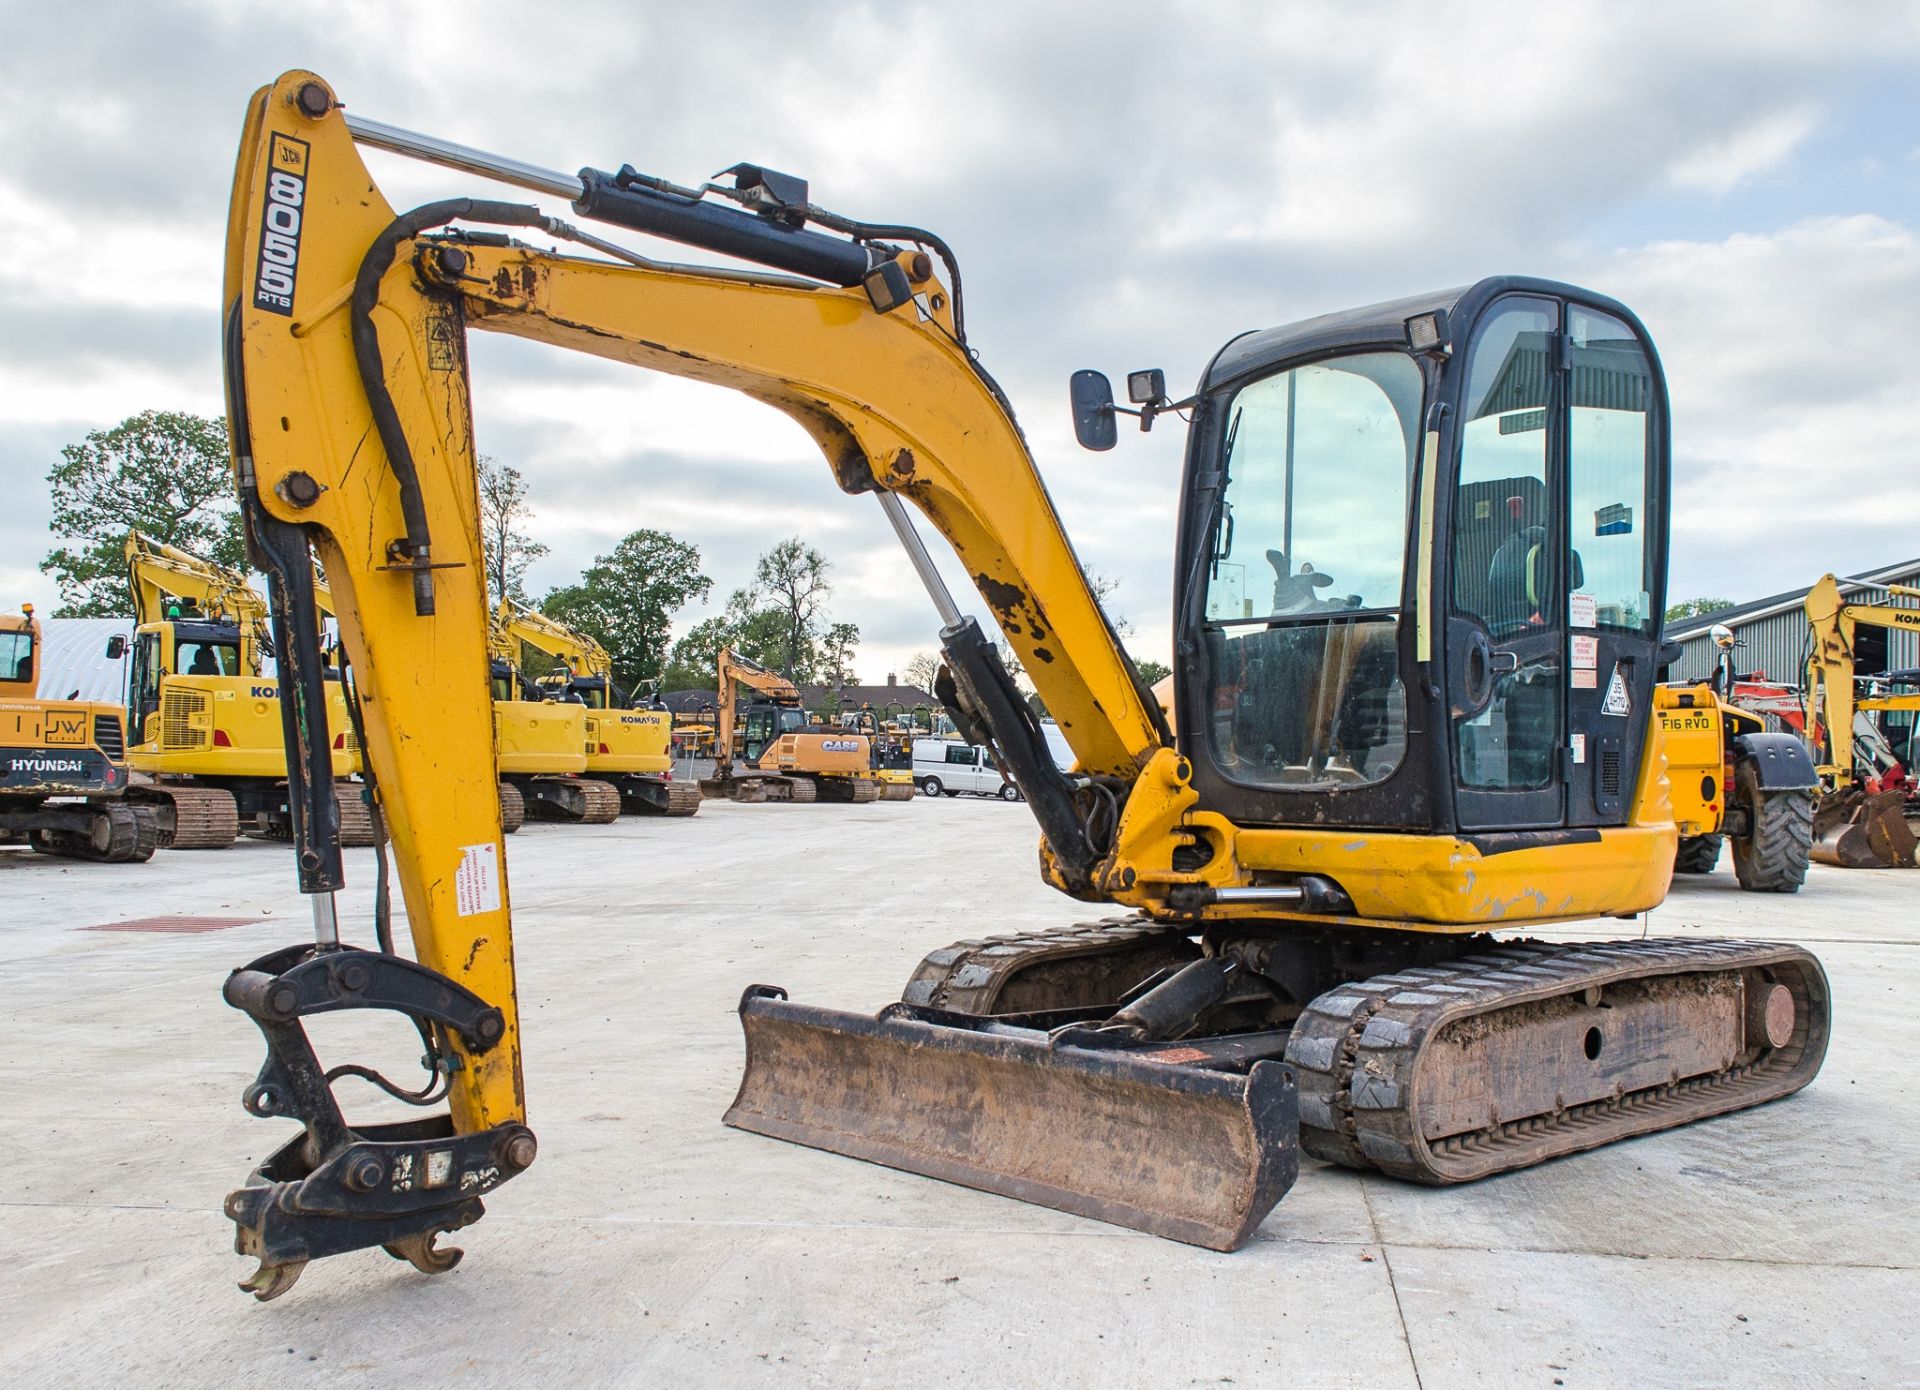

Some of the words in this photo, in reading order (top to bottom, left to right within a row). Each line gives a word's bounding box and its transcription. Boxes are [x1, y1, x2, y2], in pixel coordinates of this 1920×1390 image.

[282, 146, 300, 163] JCB
[259, 171, 304, 296] 8055
[258, 290, 291, 308] RTS
[620, 715, 660, 724] KOMATSU
[1662, 718, 1682, 730] F16
[47, 720, 83, 734] JW
[822, 740, 858, 752] CASE
